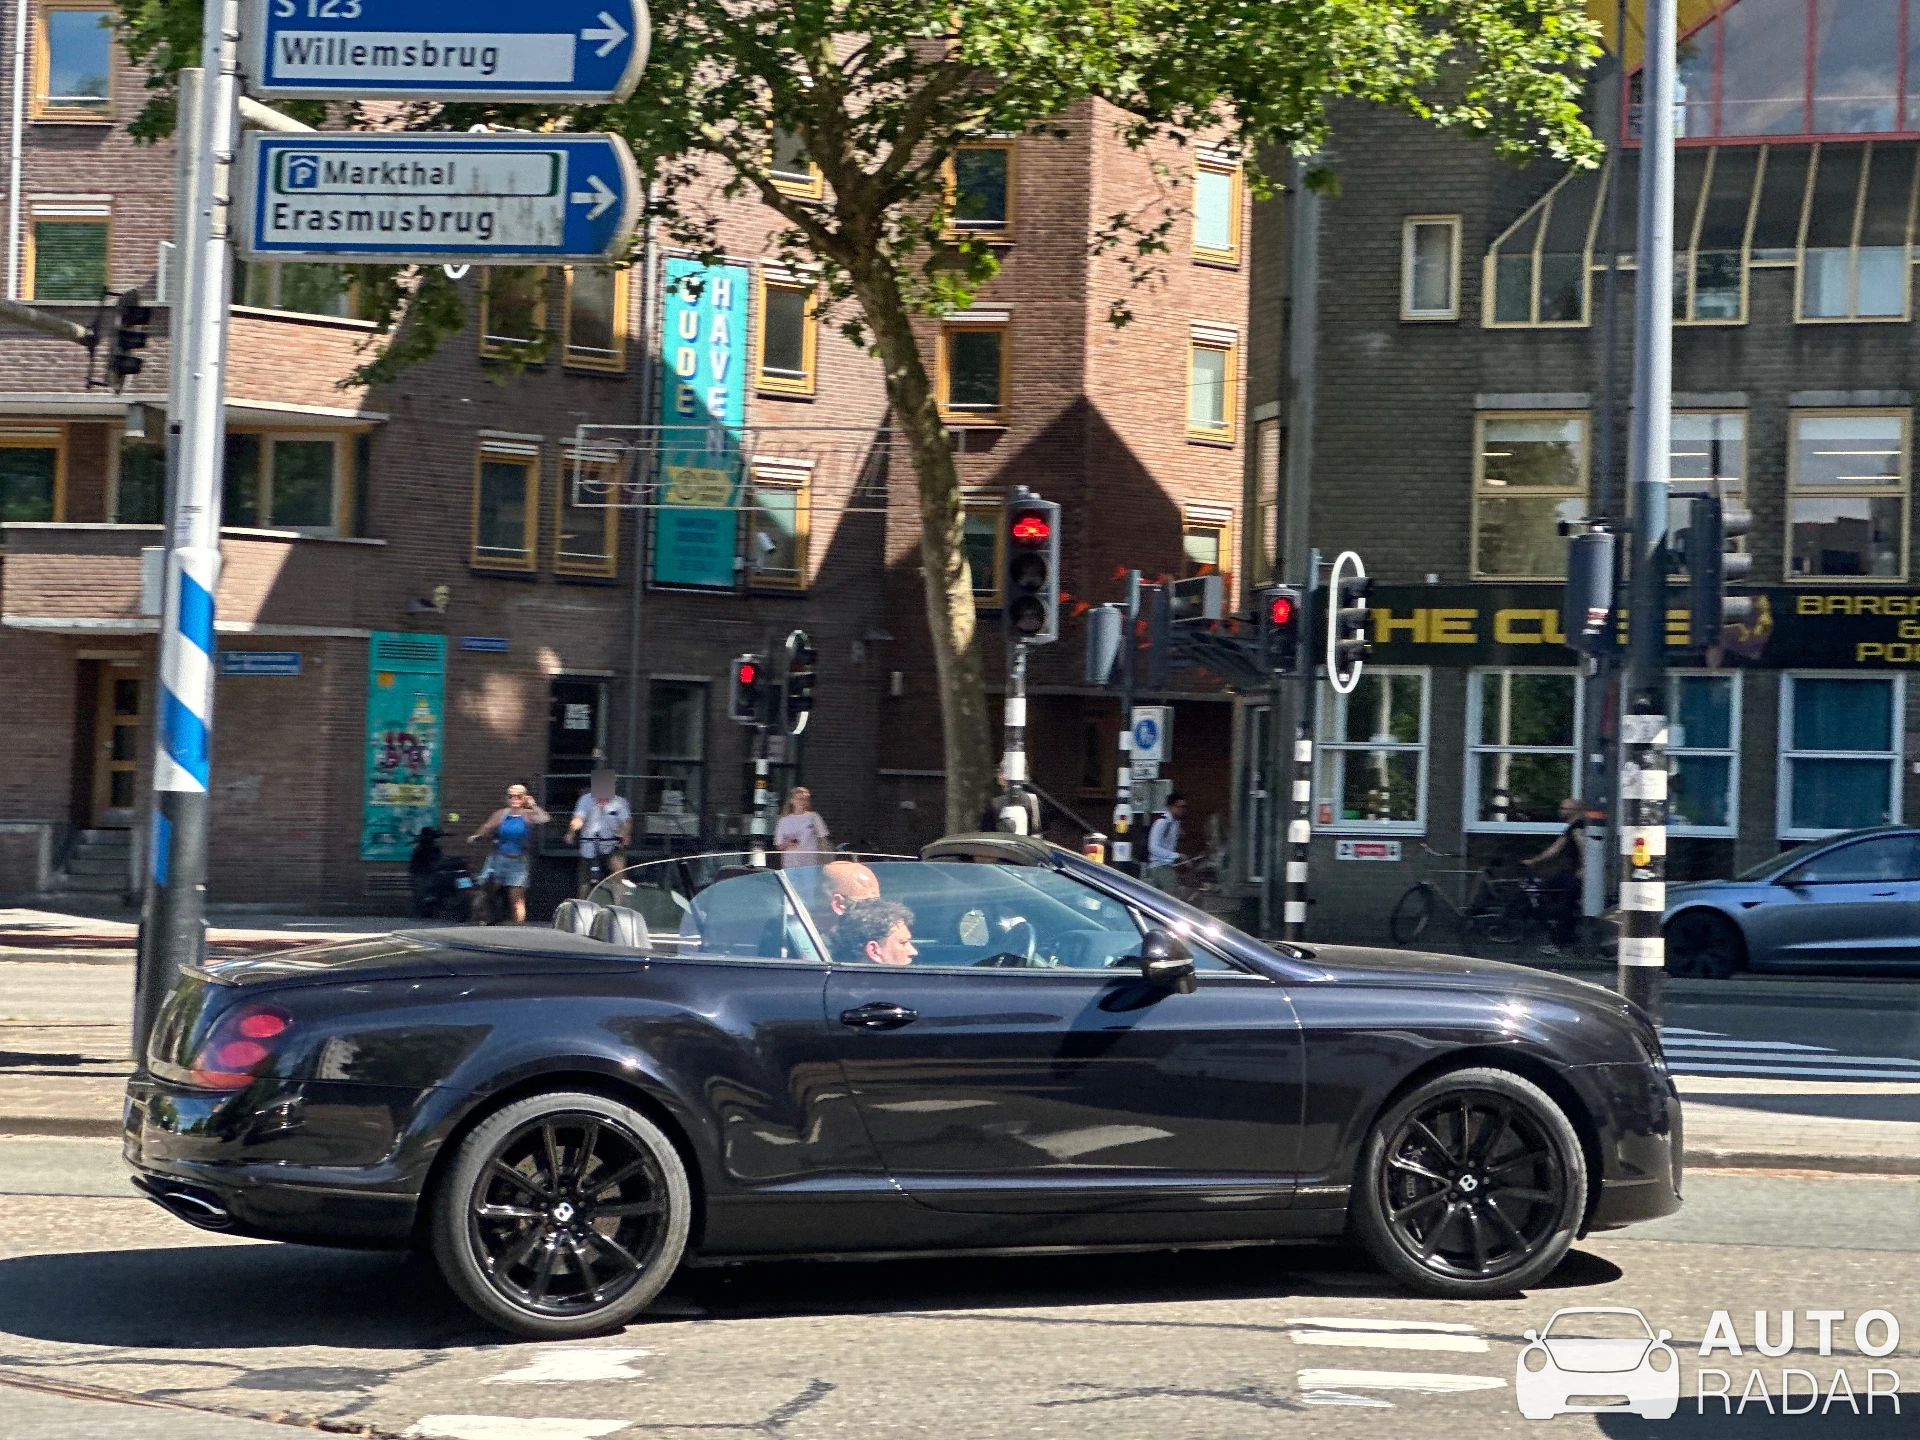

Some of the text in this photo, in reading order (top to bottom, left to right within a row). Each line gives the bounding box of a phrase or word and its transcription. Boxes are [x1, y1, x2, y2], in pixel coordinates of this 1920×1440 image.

[280, 37, 499, 75] Willemsbrug
[322, 160, 457, 186] Markthal
[272, 202, 495, 240] Erasmusbrug
[1370, 608, 1478, 644] HE
[1856, 642, 1920, 662] PO
